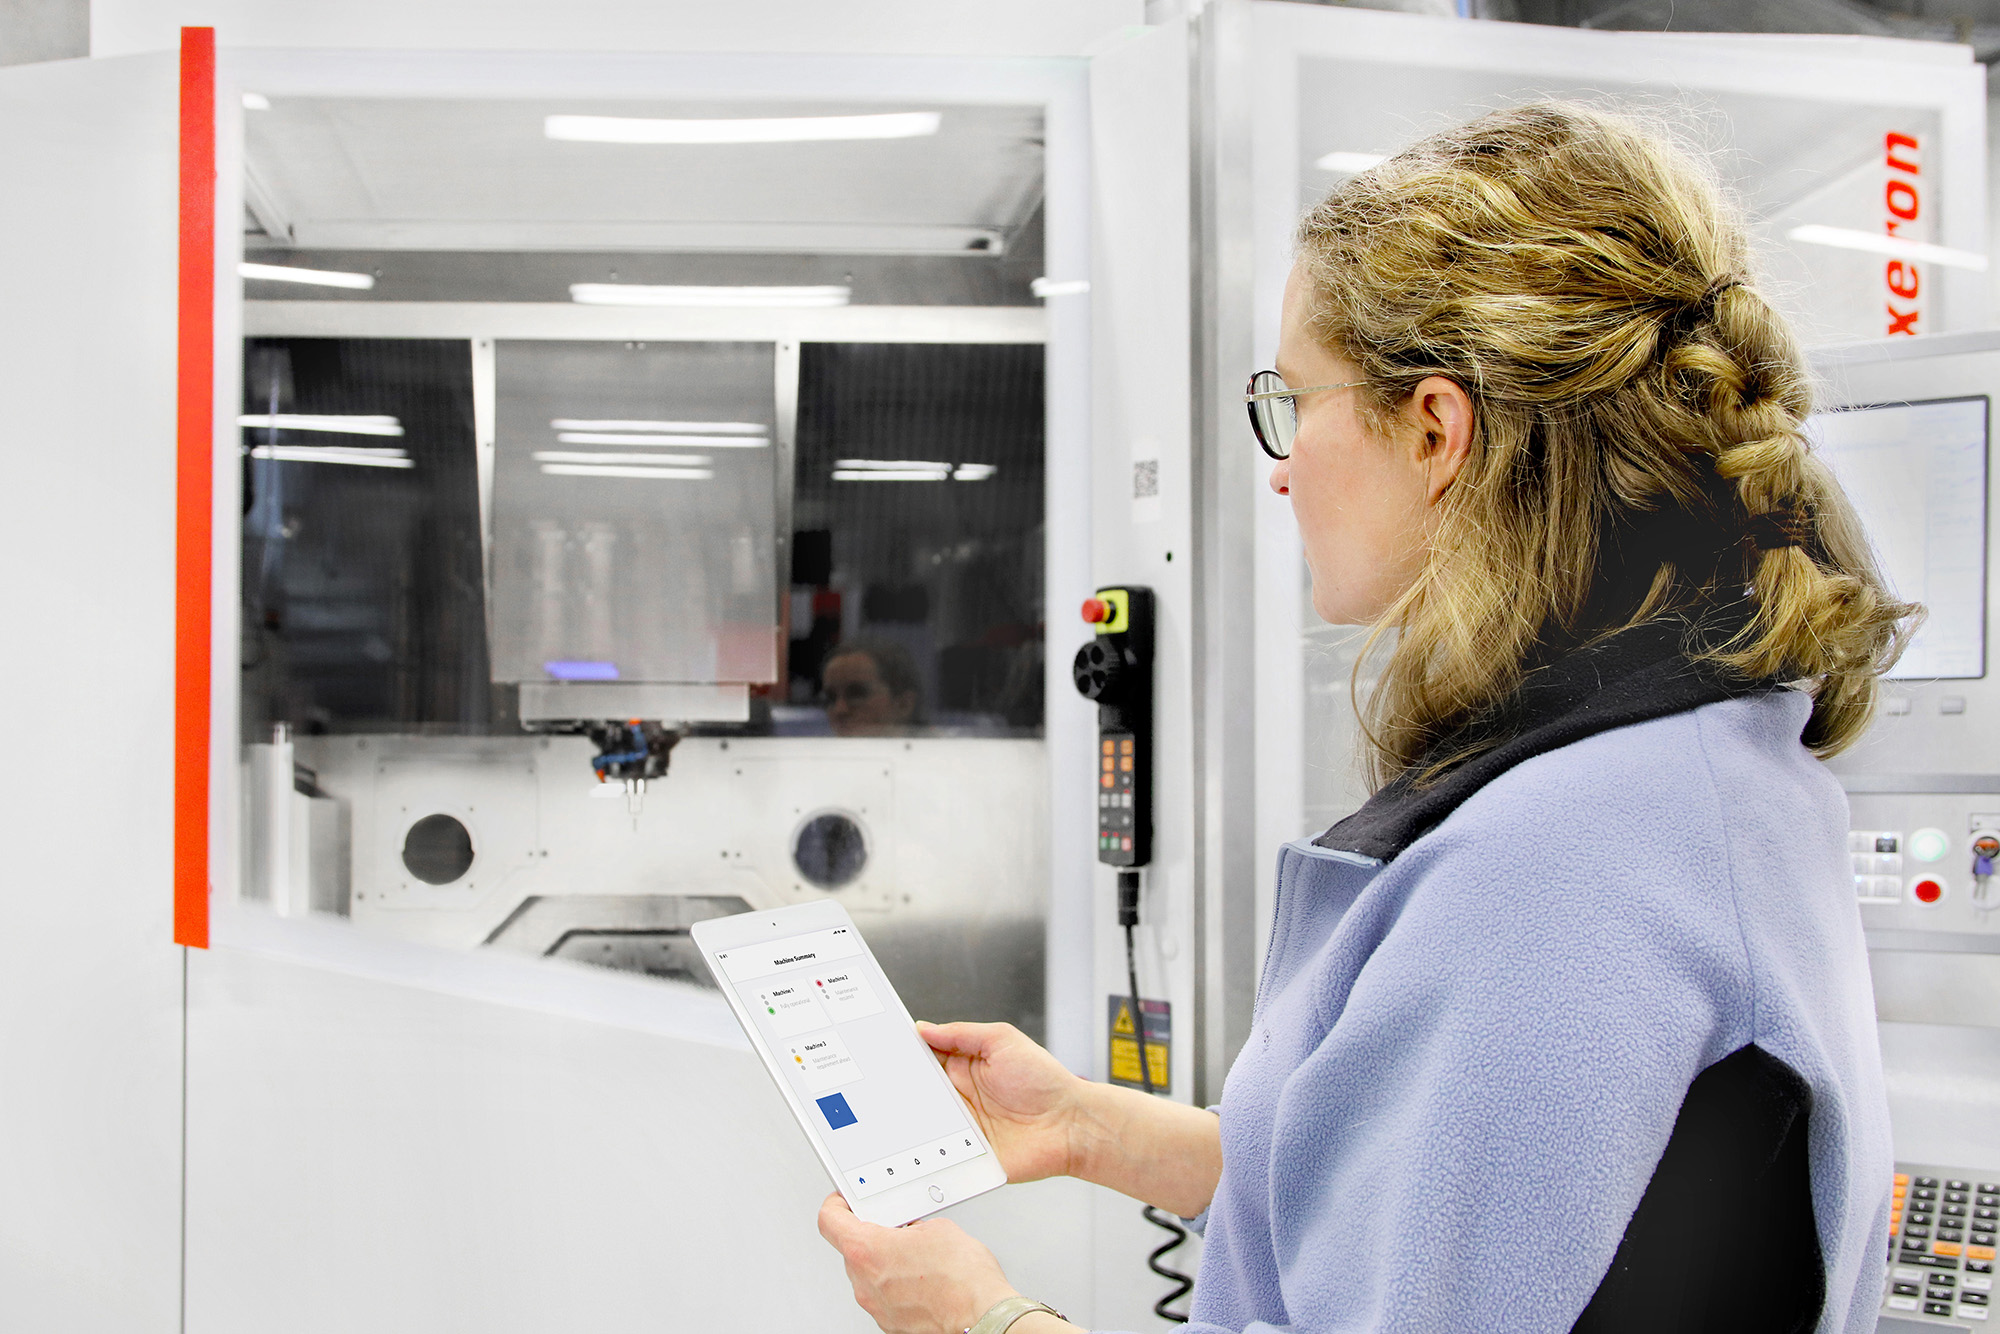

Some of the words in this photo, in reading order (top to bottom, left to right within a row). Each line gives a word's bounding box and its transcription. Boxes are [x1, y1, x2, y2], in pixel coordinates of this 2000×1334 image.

[774, 957, 794, 966] Machine
[793, 952, 816, 962] Summary
[828, 976, 845, 984] Machine
[773, 988, 791, 996] Machine
[804, 1043, 823, 1051] Machine
